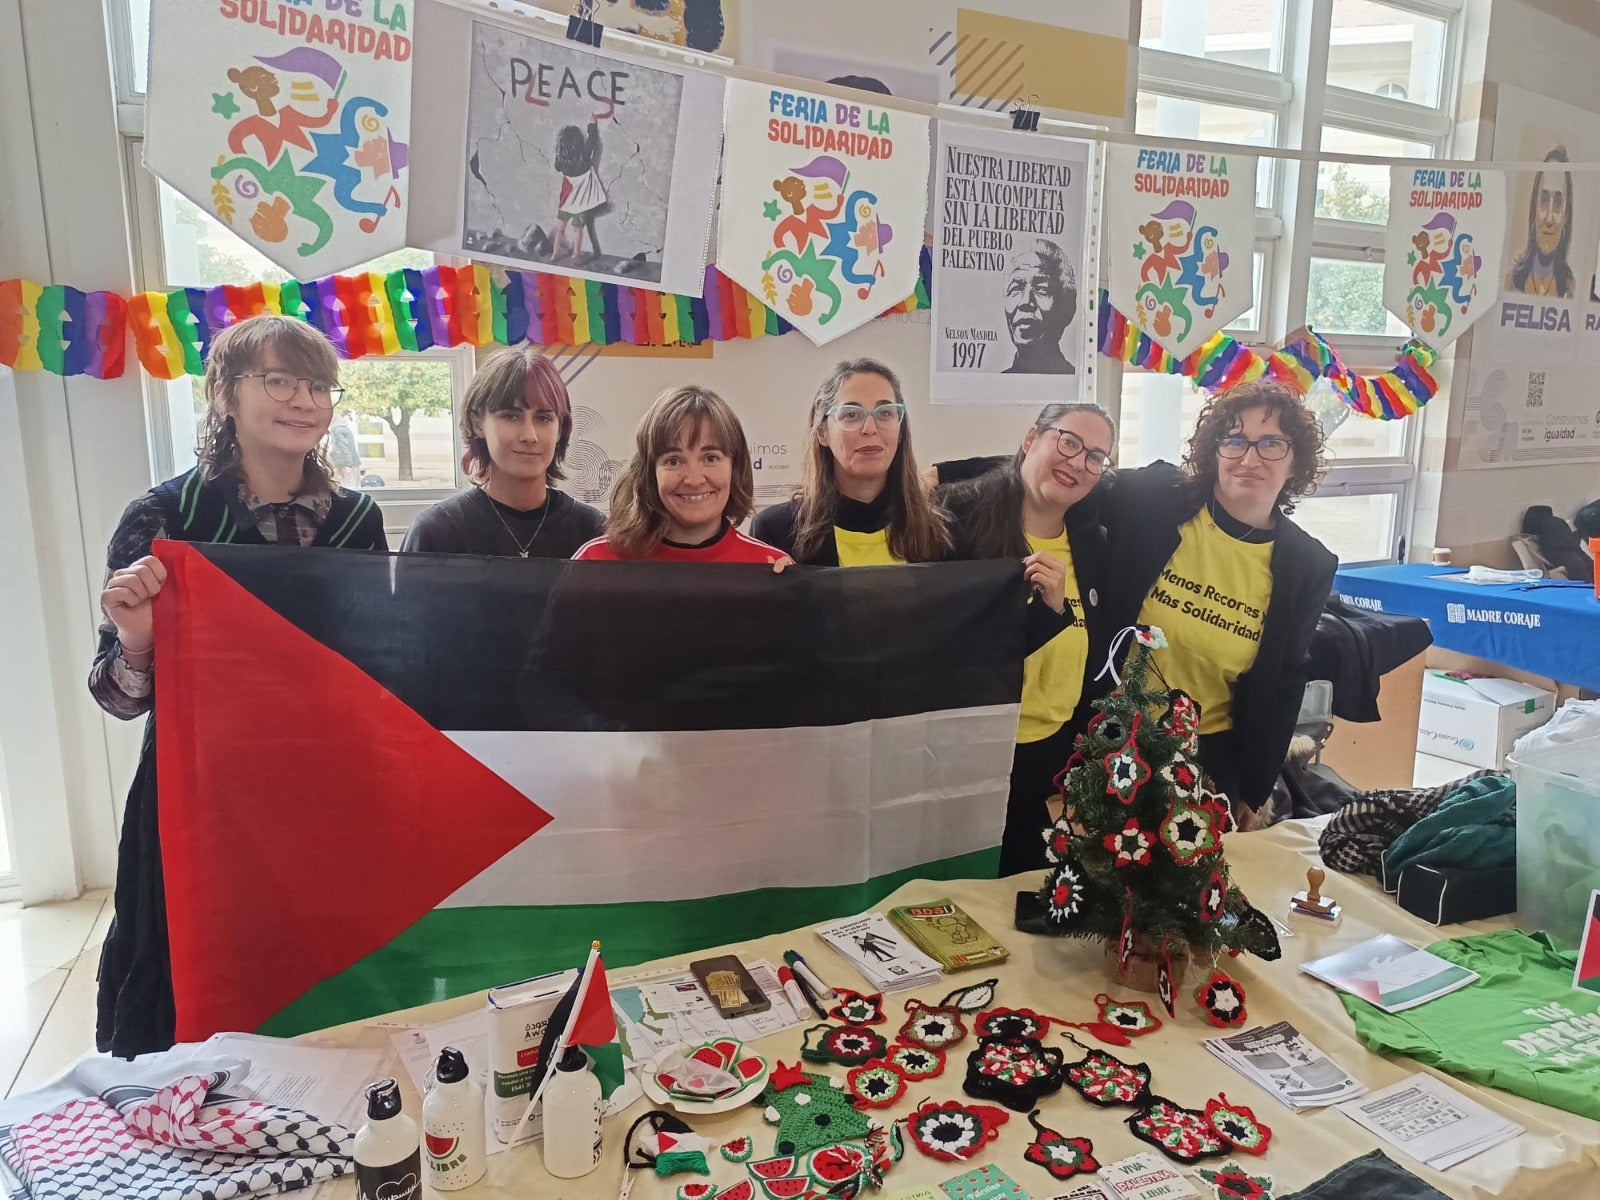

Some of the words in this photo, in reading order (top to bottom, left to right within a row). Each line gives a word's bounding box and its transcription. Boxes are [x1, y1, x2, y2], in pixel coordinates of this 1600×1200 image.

[373, 0, 407, 31] LA
[219, 0, 412, 62] SOLIDARIDAD
[769, 90, 828, 124] FERIA
[835, 103, 861, 128] DE
[867, 109, 890, 135] LA
[768, 118, 893, 160] SOLIDARIDAD
[947, 146, 1004, 180] NUESTRA
[1007, 159, 1071, 187] LIBERTAD
[1137, 149, 1181, 174] FERIA
[1186, 153, 1206, 173] DE
[1209, 155, 1227, 177] LA
[1134, 173, 1230, 199] SOLIDARIDAD
[1413, 169, 1446, 189] FERIA
[1449, 171, 1465, 188] DE
[1467, 172, 1482, 190] LA
[981, 181, 1065, 211] INCOMPLETA
[1409, 190, 1483, 210] SOLIDARIDAD
[944, 200, 969, 226] SIN
[973, 203, 990, 228] LA
[994, 205, 1065, 235] LIBERTAD
[943, 227, 965, 247] DEL
[968, 229, 1013, 251] PUEBLO
[942, 248, 1005, 272] PALESTINO
[1501, 302, 1571, 332] FELISA
[944, 327, 969, 340] NELSON
[971, 328, 998, 341] MANDELA
[952, 342, 986, 368] 1997
[1544, 428, 1576, 443] igualdad
[1161, 569, 1202, 594] Menos
[1354, 596, 1383, 612] CORAJE
[1181, 600, 1261, 642] Solidaridad
[1466, 609, 1502, 623] MADRE
[1504, 611, 1541, 629] CORAJE
[430, 1153, 467, 1172] LIBRE
[1118, 1162, 1148, 1174] VIVA
[1114, 1169, 1179, 1192] PALESTINA
[1139, 1185, 1171, 1200] LIBRE
